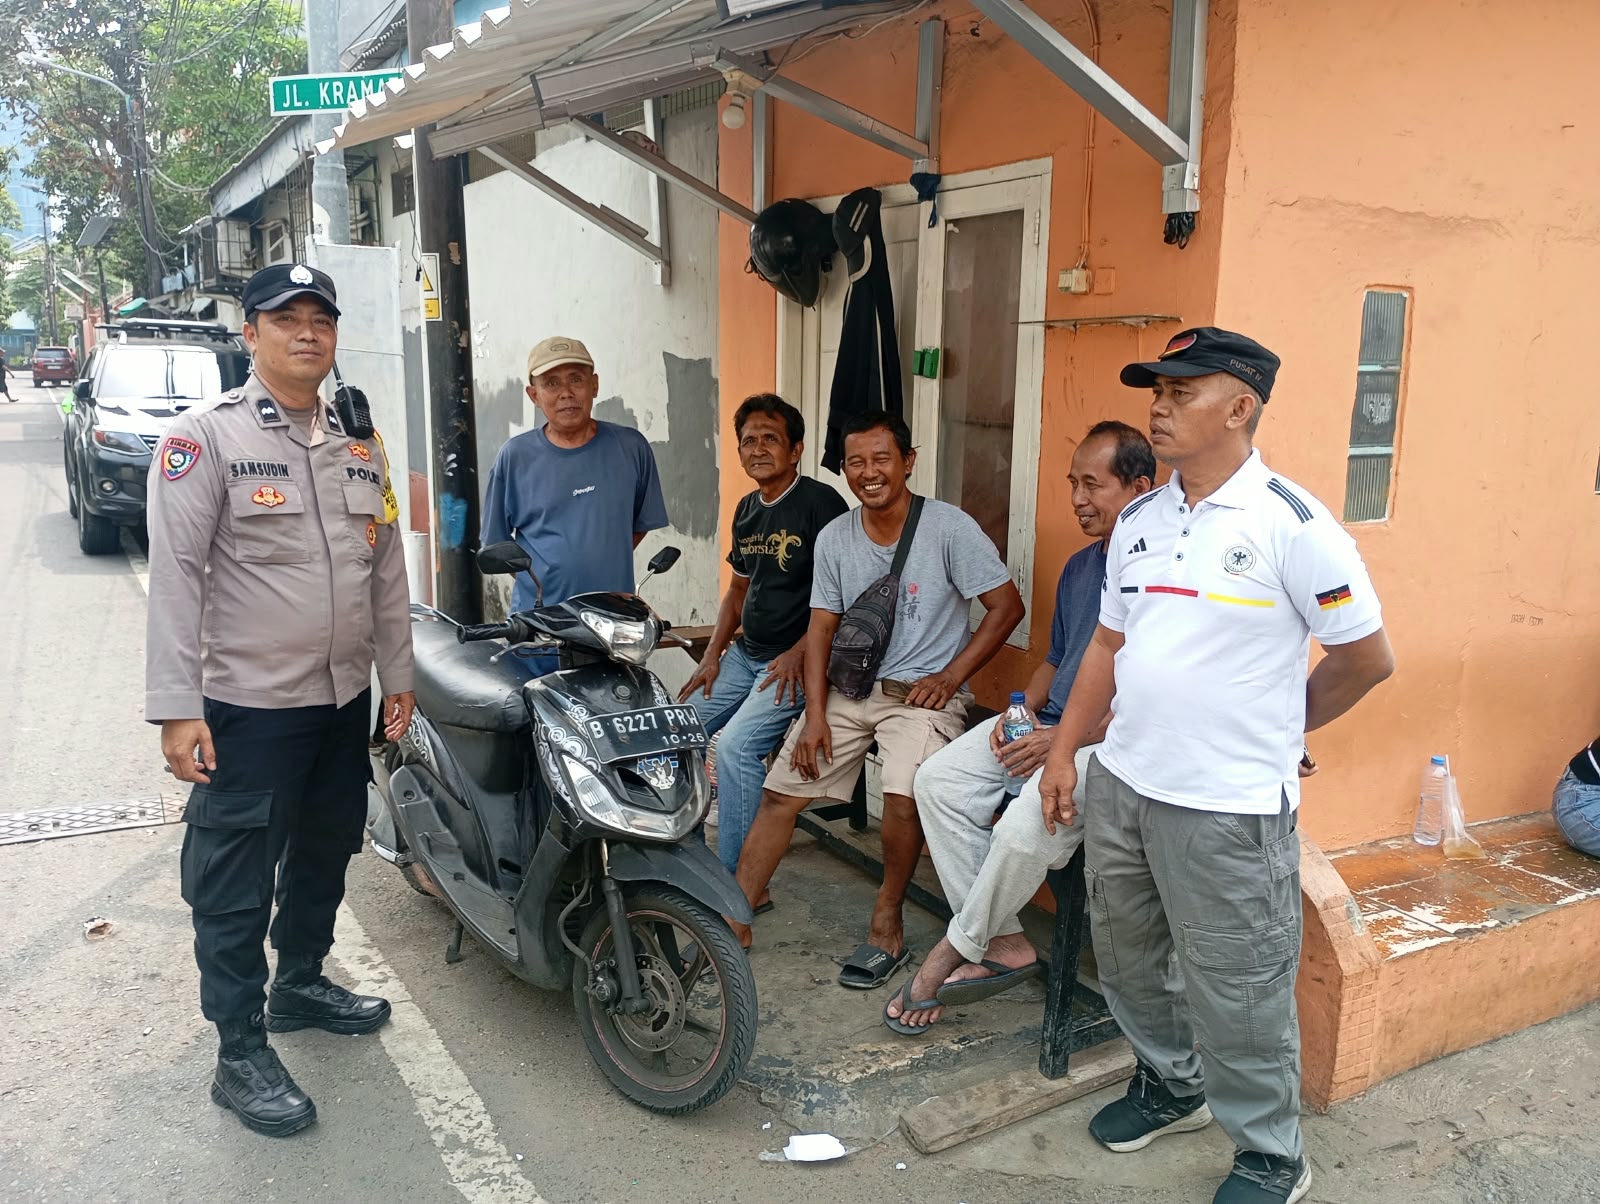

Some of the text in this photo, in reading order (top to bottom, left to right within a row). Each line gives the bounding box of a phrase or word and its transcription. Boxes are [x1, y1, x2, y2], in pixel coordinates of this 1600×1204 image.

[282, 77, 398, 108] JL. KRAMA
[1229, 358, 1256, 376] PUSAT
[230, 461, 290, 478] SAMSUDIN
[589, 708, 699, 739] B 6227 PRW
